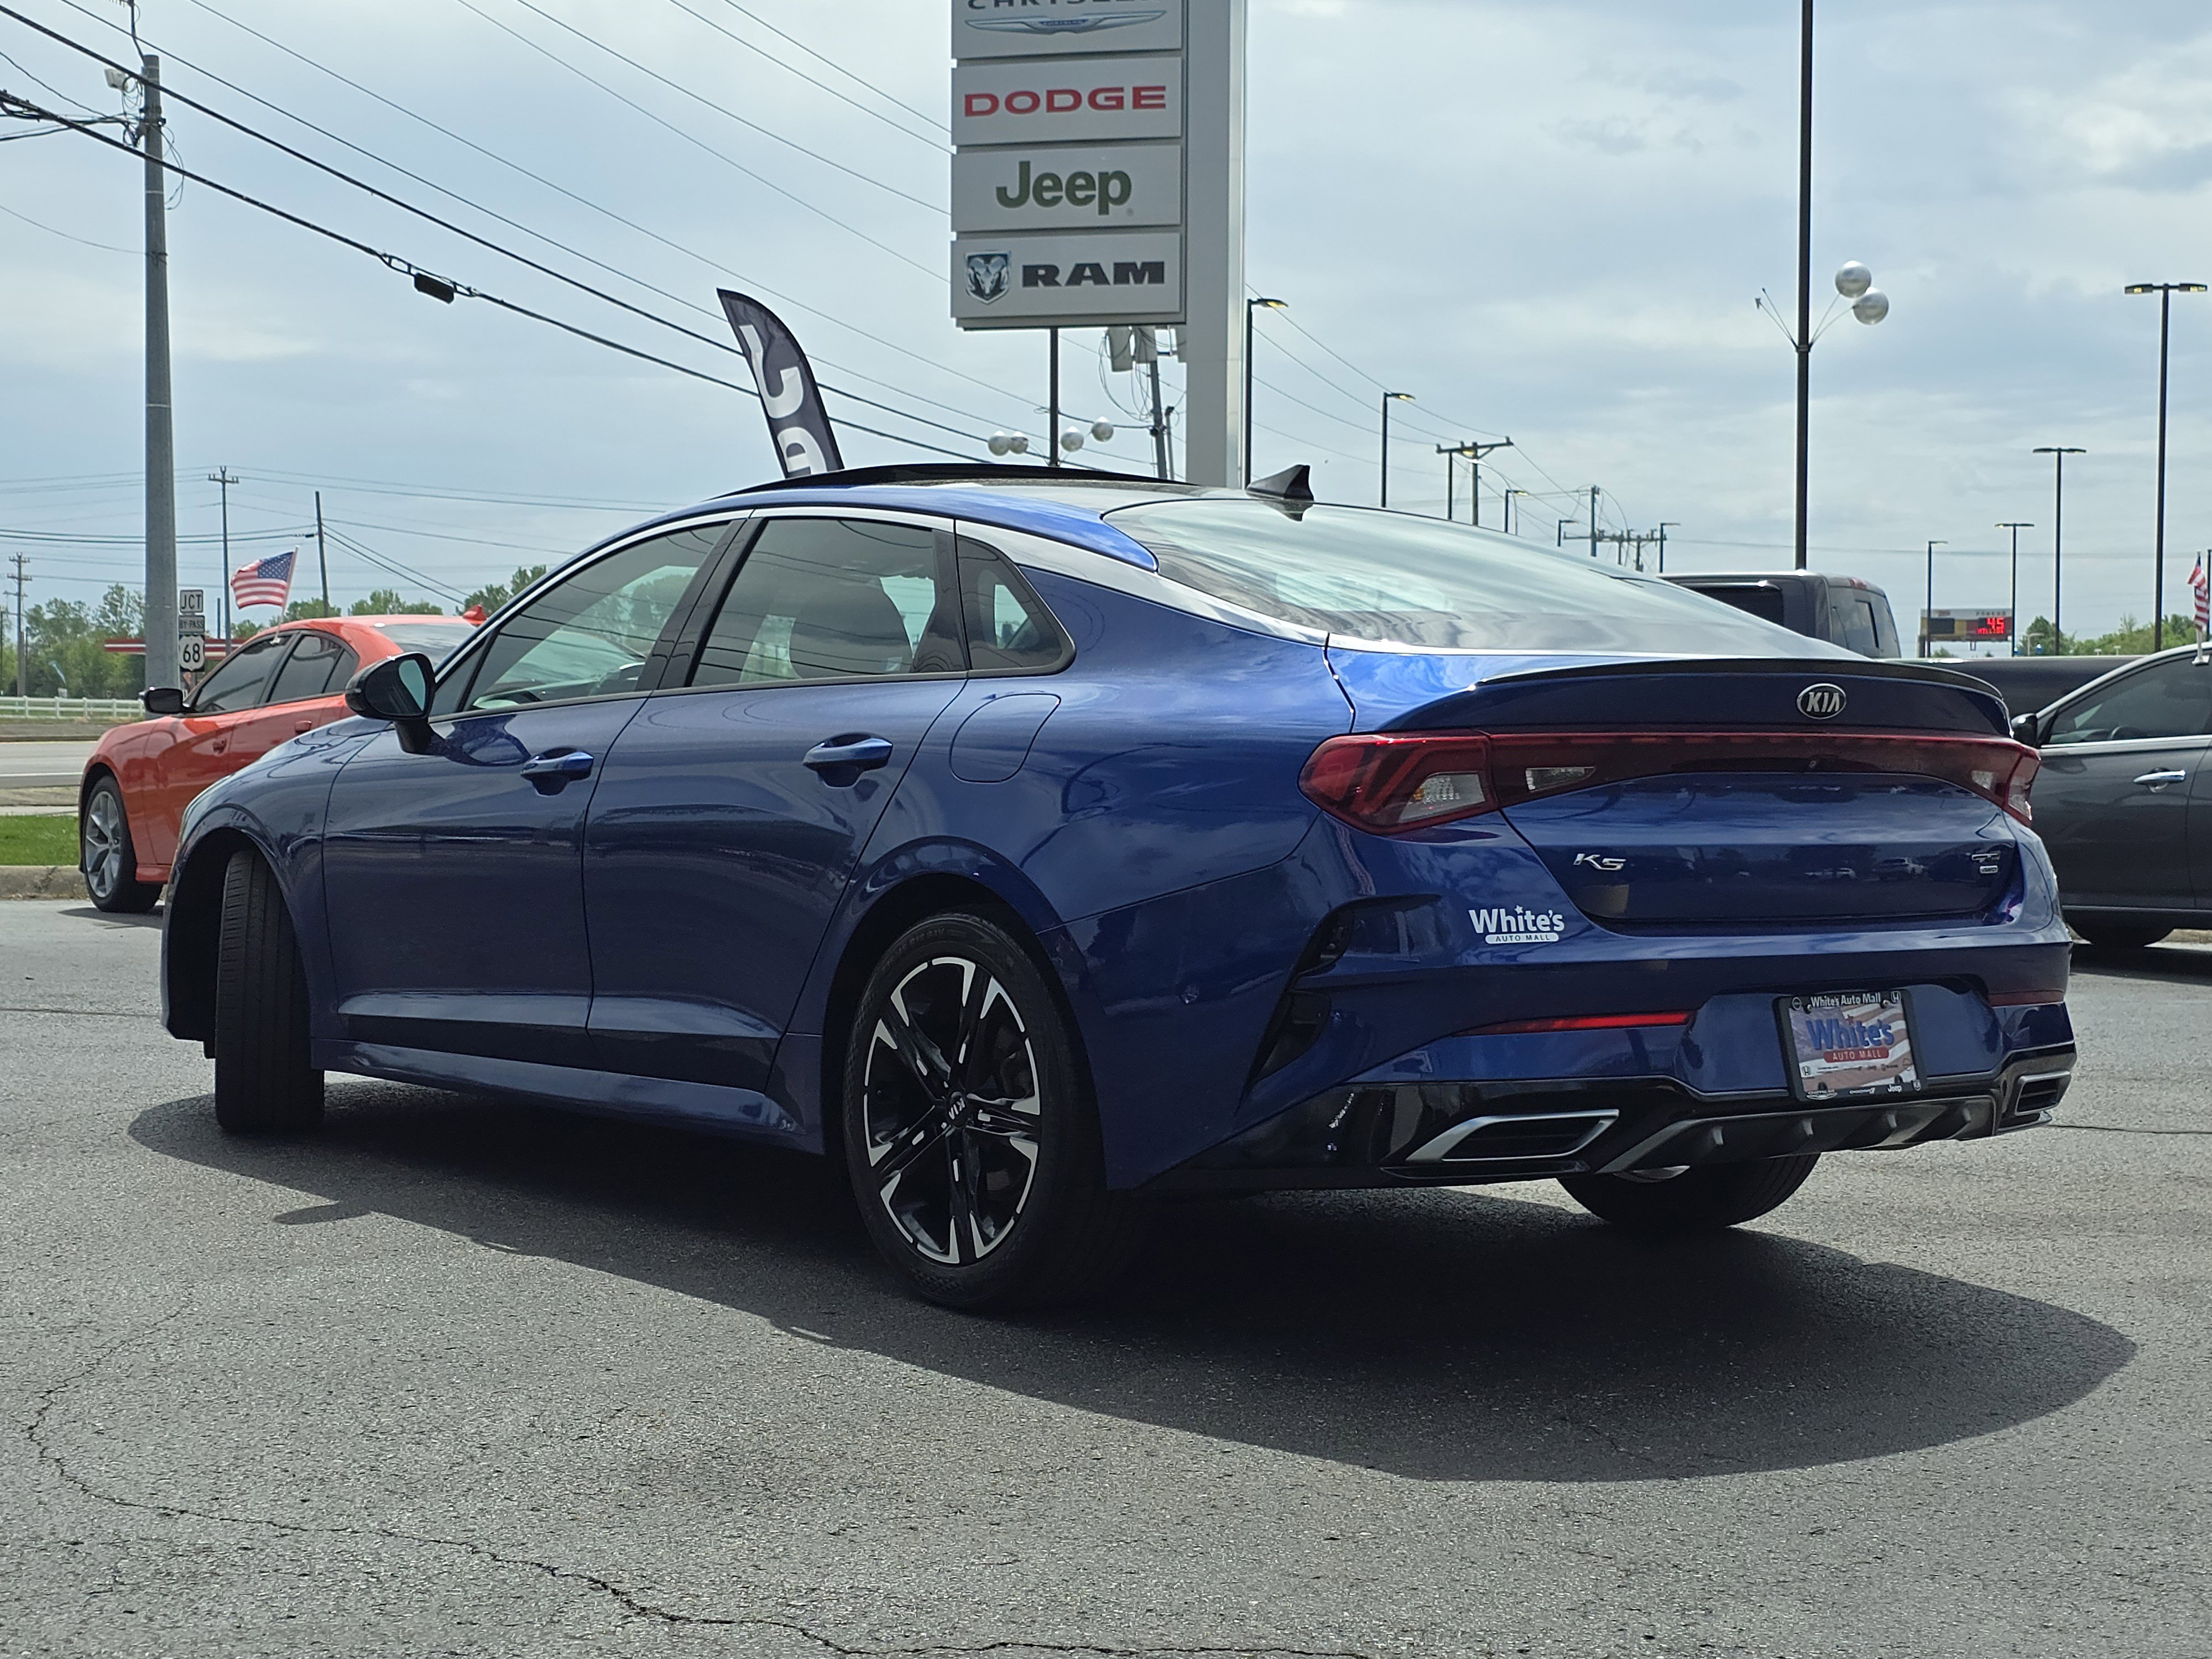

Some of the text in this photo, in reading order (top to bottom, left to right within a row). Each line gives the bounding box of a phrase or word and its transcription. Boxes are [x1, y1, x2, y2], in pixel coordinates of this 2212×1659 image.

[964, 86, 1166, 117] DODGE
[995, 160, 1132, 216] Jeep
[1021, 262, 1165, 288] RAM
[181, 594, 202, 609] JCT
[1986, 617, 2004, 629] 45
[183, 643, 200, 663] 68
[1806, 691, 1840, 713] KIA
[1573, 853, 1627, 871] K5
[1468, 906, 1565, 934] White's
[1811, 992, 1881, 1008] White's Auto Mall
[1805, 1016, 1895, 1050] White's
[1832, 1049, 1882, 1061] AUTO MALL
